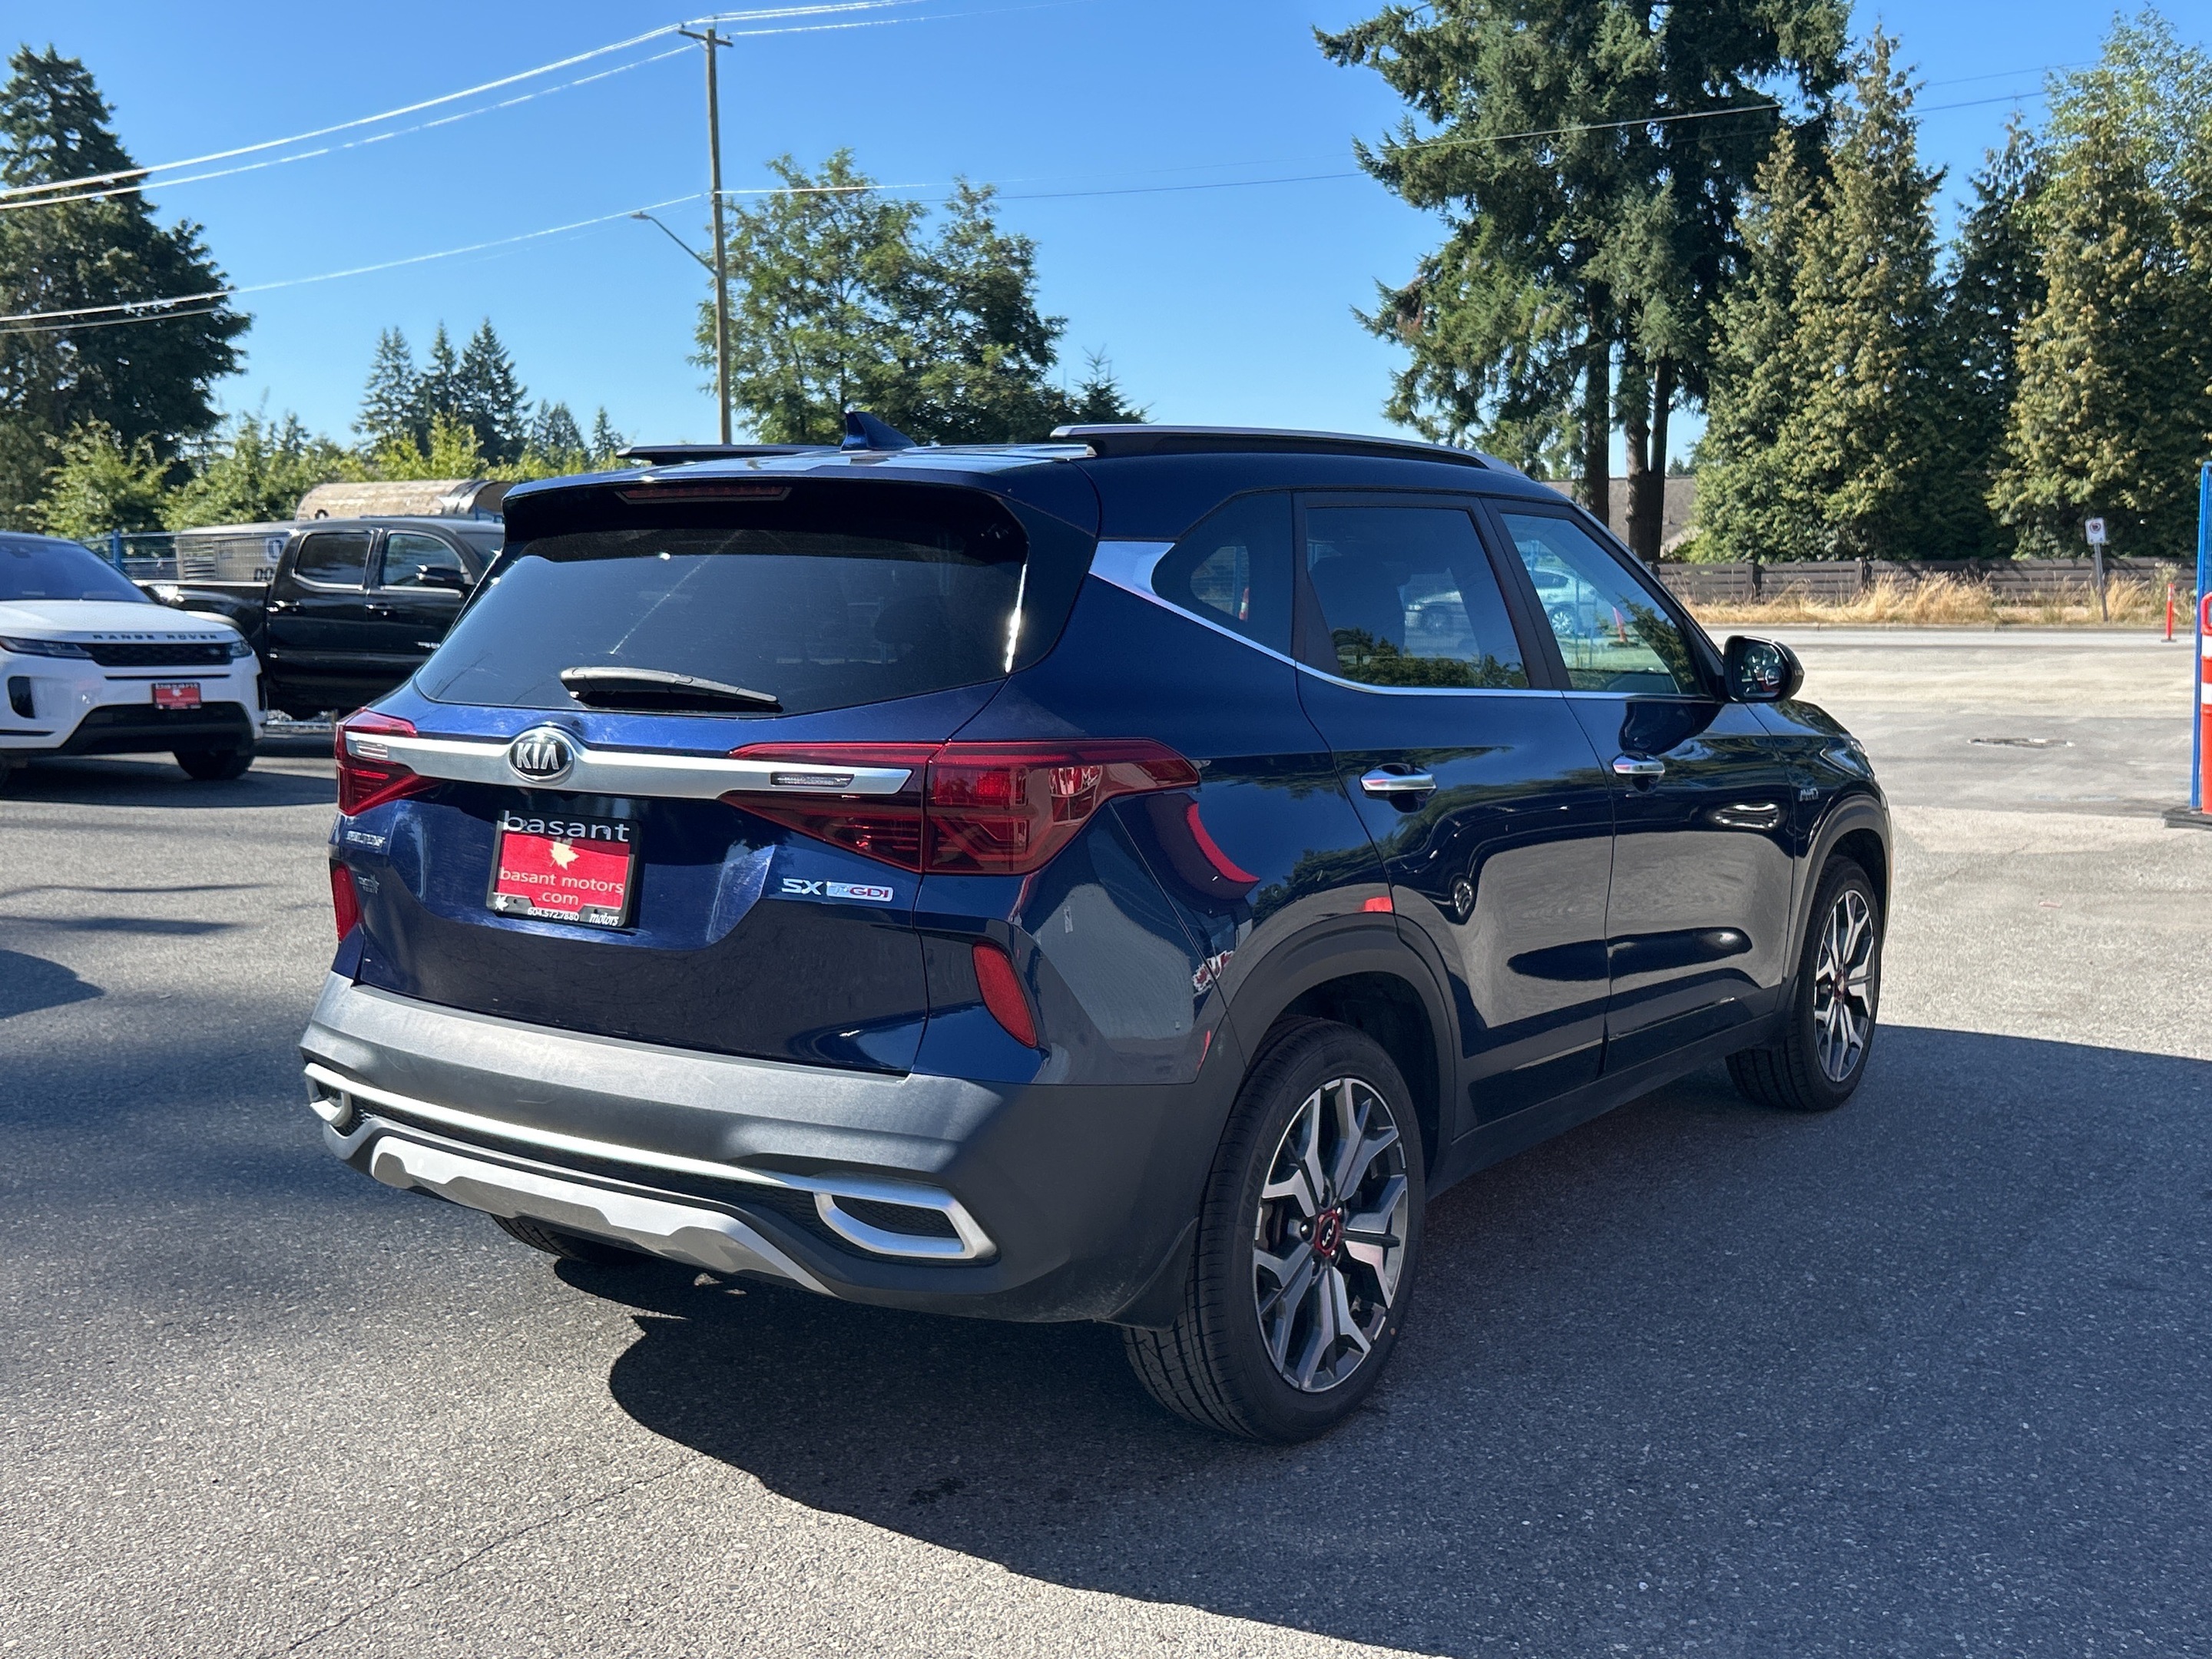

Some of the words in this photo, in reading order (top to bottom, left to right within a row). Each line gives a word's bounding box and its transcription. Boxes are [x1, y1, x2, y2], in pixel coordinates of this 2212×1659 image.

[517, 743, 559, 770] KIA
[503, 810, 630, 842] basant
[498, 866, 557, 885] basant
[561, 876, 624, 894] motors
[781, 878, 824, 896] SX
[538, 892, 579, 905] .com
[589, 912, 620, 926] motors
